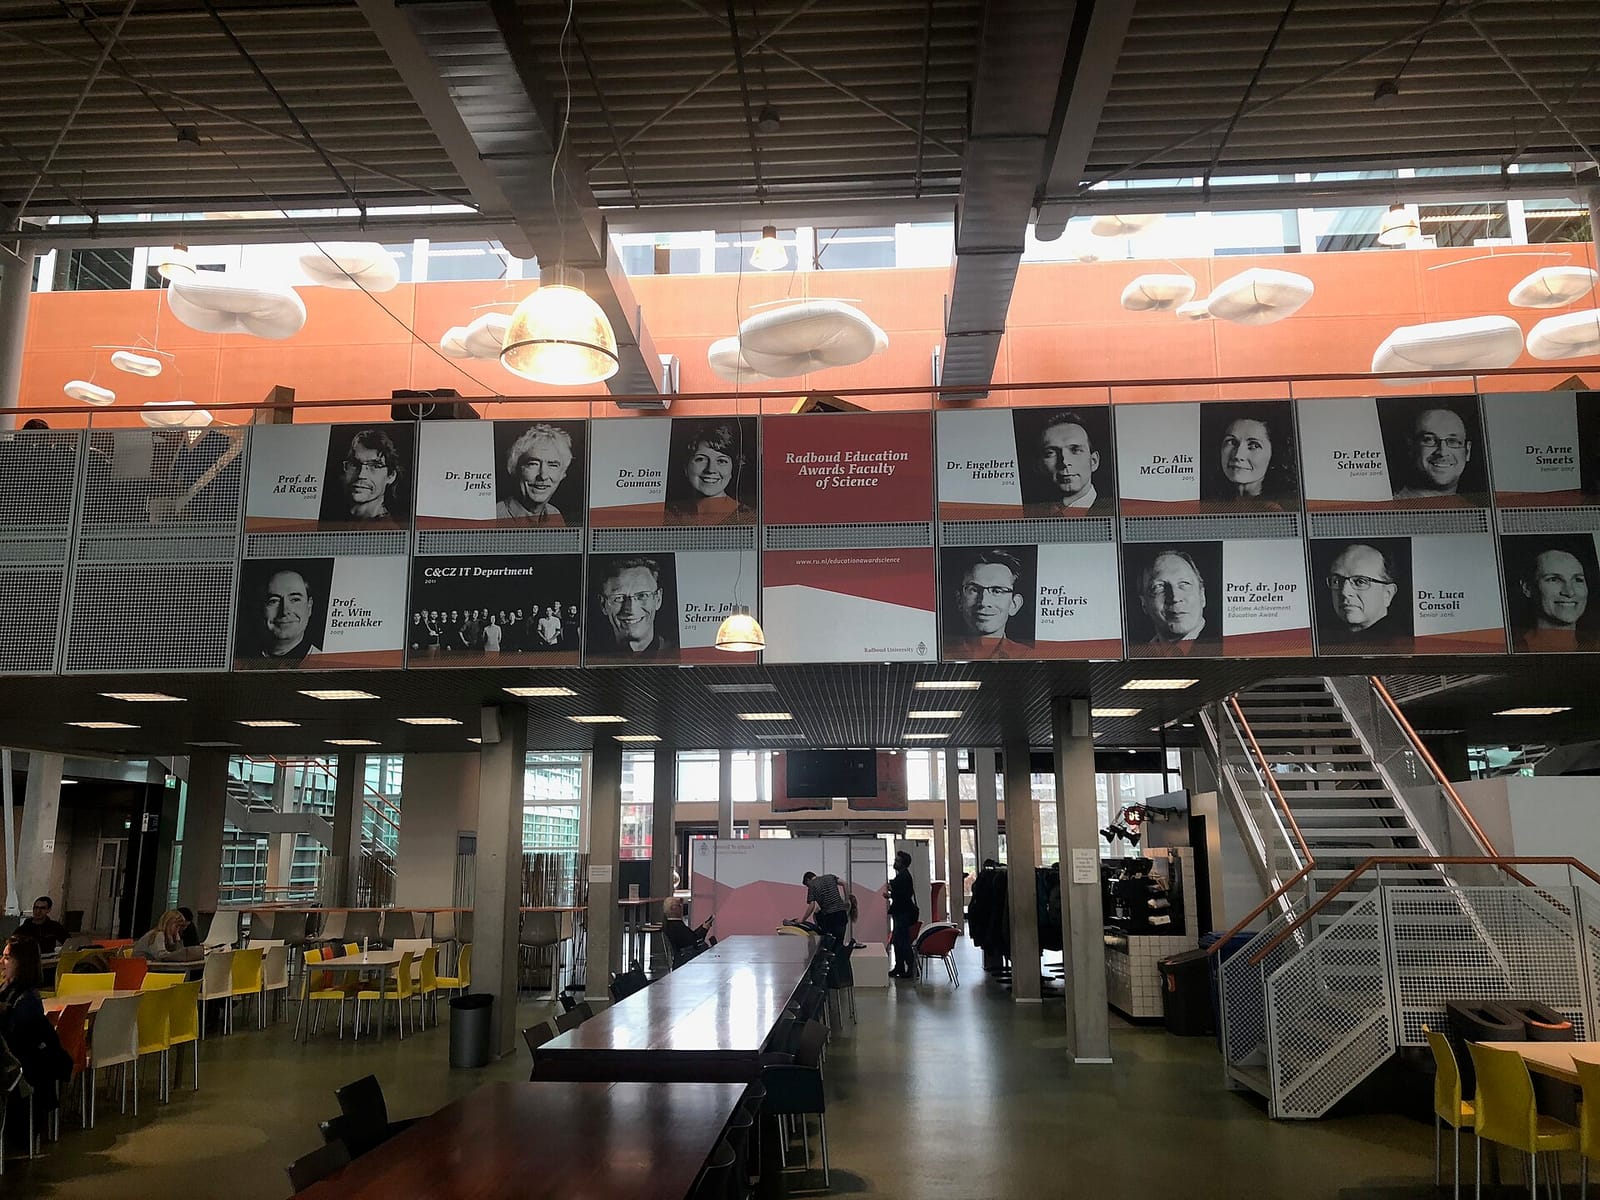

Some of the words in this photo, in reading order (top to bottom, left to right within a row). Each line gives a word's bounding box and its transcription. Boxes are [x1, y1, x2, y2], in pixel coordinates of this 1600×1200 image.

[1333, 451, 1350, 459] Dr.
[1353, 450, 1381, 459] Peter
[1525, 446, 1543, 454] Dr.
[1546, 445, 1572, 454] Arne
[785, 451, 841, 464] Radboud
[844, 450, 908, 462] Education
[1153, 455, 1169, 464] Dr.
[1172, 454, 1194, 463] Alix
[1536, 455, 1574, 465] Smeets
[799, 464, 845, 476] Awards
[849, 463, 895, 476] Faculty
[946, 461, 962, 470] Dr.
[966, 460, 1014, 470] Engelbert
[1140, 465, 1194, 475] McCollam
[1337, 461, 1382, 470] Schwabe
[445, 472, 460, 480] Dr.
[464, 471, 492, 480] Bruce
[619, 469, 634, 478] Dr.
[638, 469, 661, 478] Dion
[972, 470, 1015, 479] Hubbers
[278, 474, 301, 484] Prof.
[304, 474, 317, 483] dr.
[616, 479, 661, 488] Coumans
[816, 476, 830, 490] of
[831, 476, 878, 487] Science
[272, 485, 286, 494] Ad
[290, 485, 318, 495] Ragas
[464, 481, 492, 491] Jenks
[424, 567, 457, 577] C&CZ
[459, 567, 471, 576] IT
[473, 566, 533, 578] Department
[1040, 586, 1066, 596] Prof.
[1227, 582, 1253, 593] Prof.
[1256, 582, 1270, 591] dr.
[1273, 582, 1297, 592] Joop
[1249, 593, 1284, 602] Zoelen
[1418, 590, 1435, 599] Dr.
[1438, 590, 1465, 599] Luca
[332, 598, 357, 608] Prof.
[1040, 597, 1054, 606] dr.
[1058, 596, 1088, 606] Floris
[1419, 600, 1460, 610] Consoli
[331, 608, 344, 617] dr.
[348, 608, 372, 617] Wim
[685, 603, 701, 612] Dr.
[704, 603, 715, 612] Ir.
[1041, 607, 1074, 618] Rutjes
[331, 618, 383, 628] Beenakker
